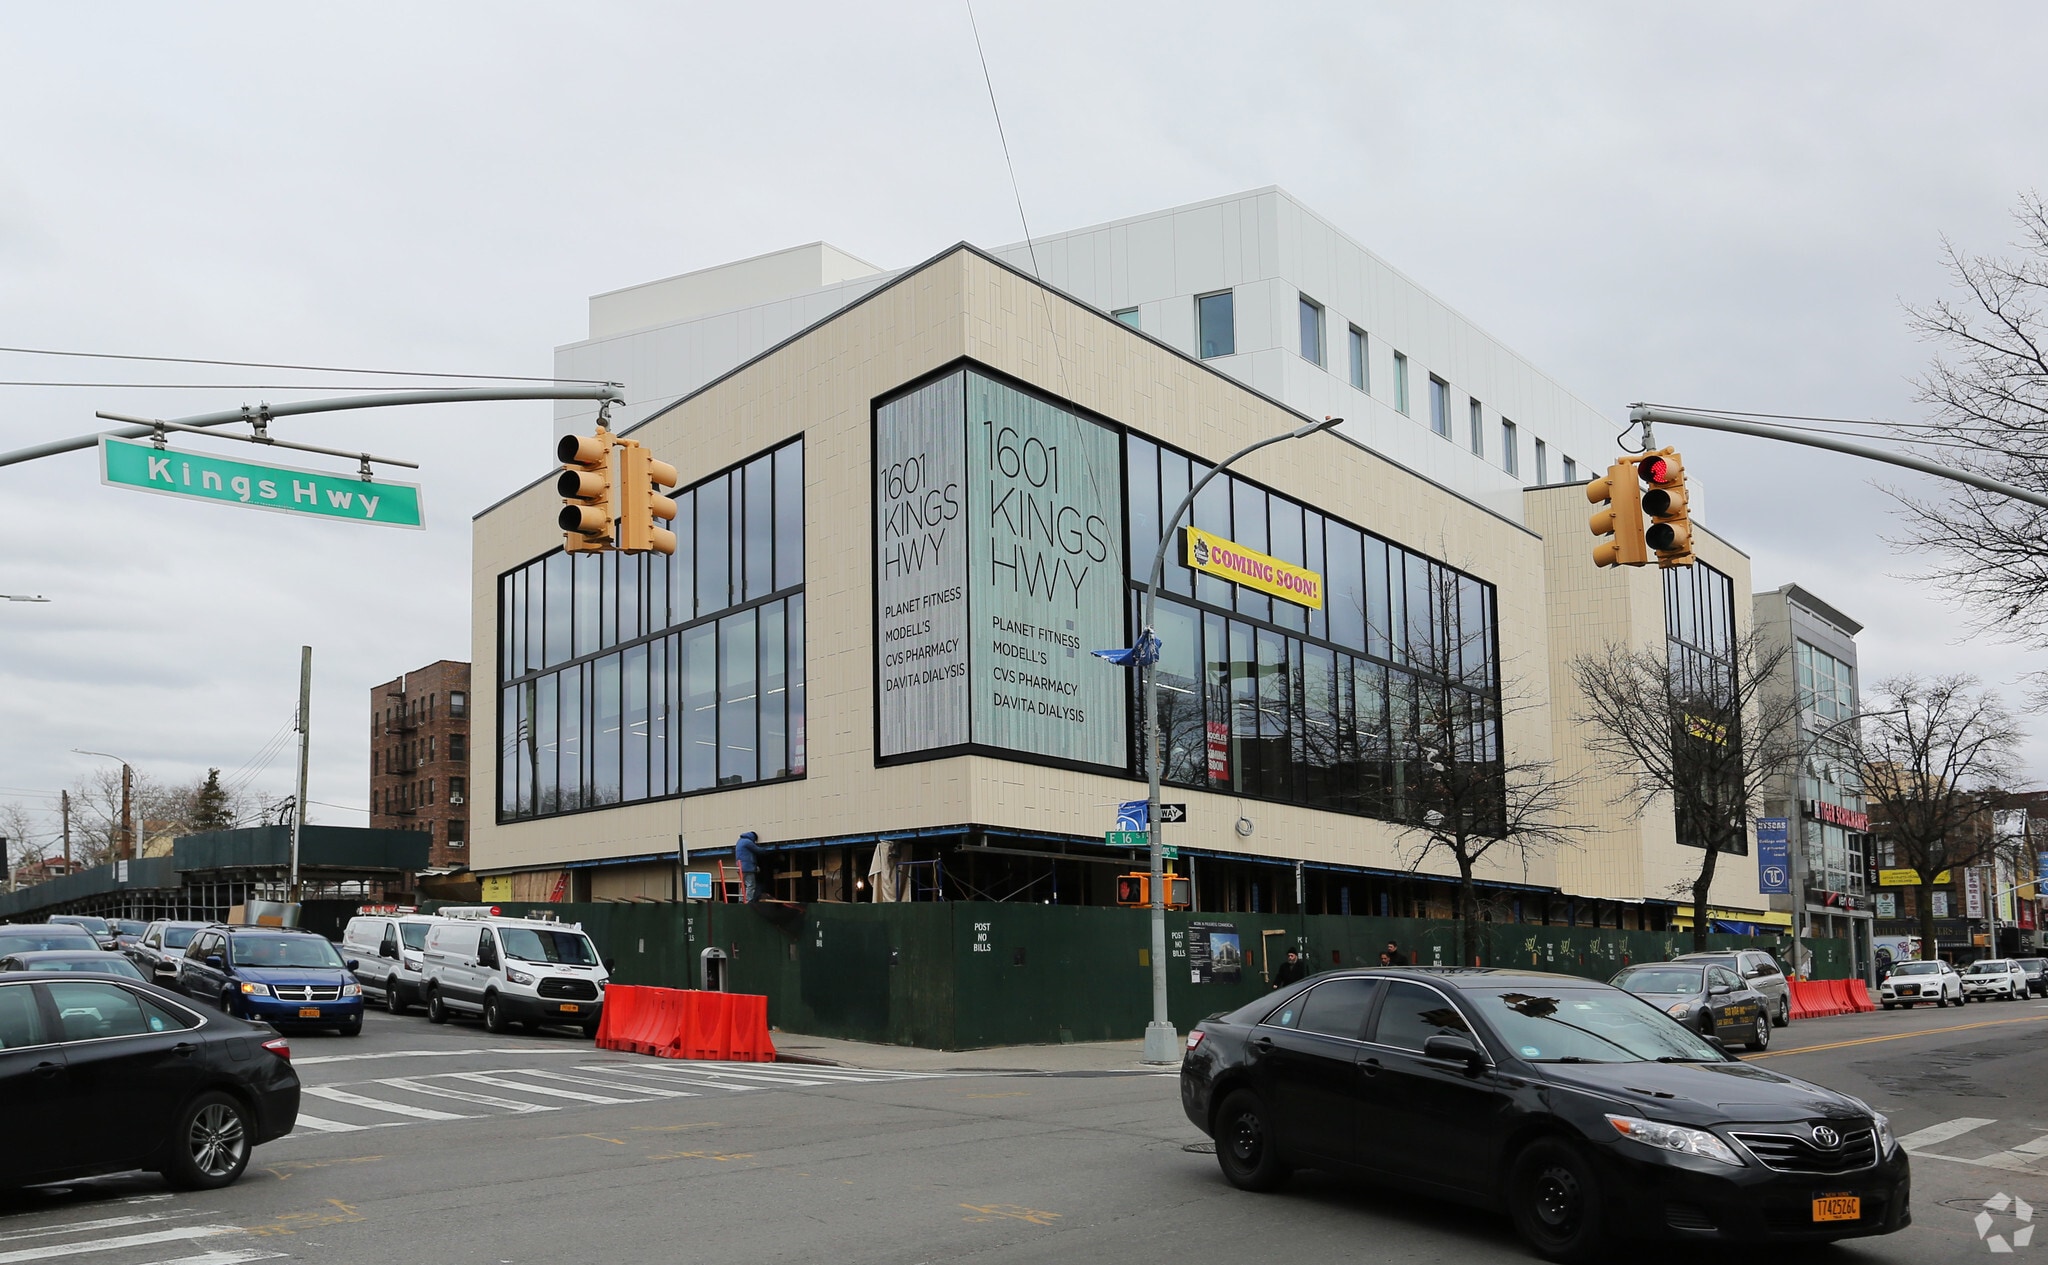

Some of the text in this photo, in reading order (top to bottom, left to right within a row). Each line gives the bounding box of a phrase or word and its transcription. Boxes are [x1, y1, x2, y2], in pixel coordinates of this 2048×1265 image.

[983, 420, 1058, 494] 1601
[147, 455, 380, 519] Kings Hwy
[881, 453, 926, 502] 1601
[884, 483, 959, 552] KINGS
[990, 479, 1107, 563] KINGS
[885, 528, 946, 581] HWY
[991, 536, 1089, 609] HWY
[1211, 546, 1273, 583] COMING
[1276, 569, 1318, 599] SOON!
[885, 586, 962, 619] PLANET FITNESS
[885, 620, 931, 643] MODELL'S
[992, 615, 1081, 650] PLANET FITNESS
[885, 638, 960, 667] CVS PHARMACY
[992, 640, 1048, 665] MODELL'S
[886, 662, 966, 692] DAVITA DIALYSIS
[992, 666, 1078, 697] CVS PHARMACY
[993, 692, 1085, 723] DAVITA DIALYSIS
[1161, 809, 1178, 817] WAY
[1109, 832, 1117, 844] E
[1122, 833, 1132, 844] 16
[974, 923, 991, 931] POST
[977, 933, 988, 942] NO
[1171, 931, 1184, 939] POST
[973, 943, 992, 952] BILLS
[1172, 949, 1186, 957] BILLS
[1817, 1198, 1857, 1216] T742526C
